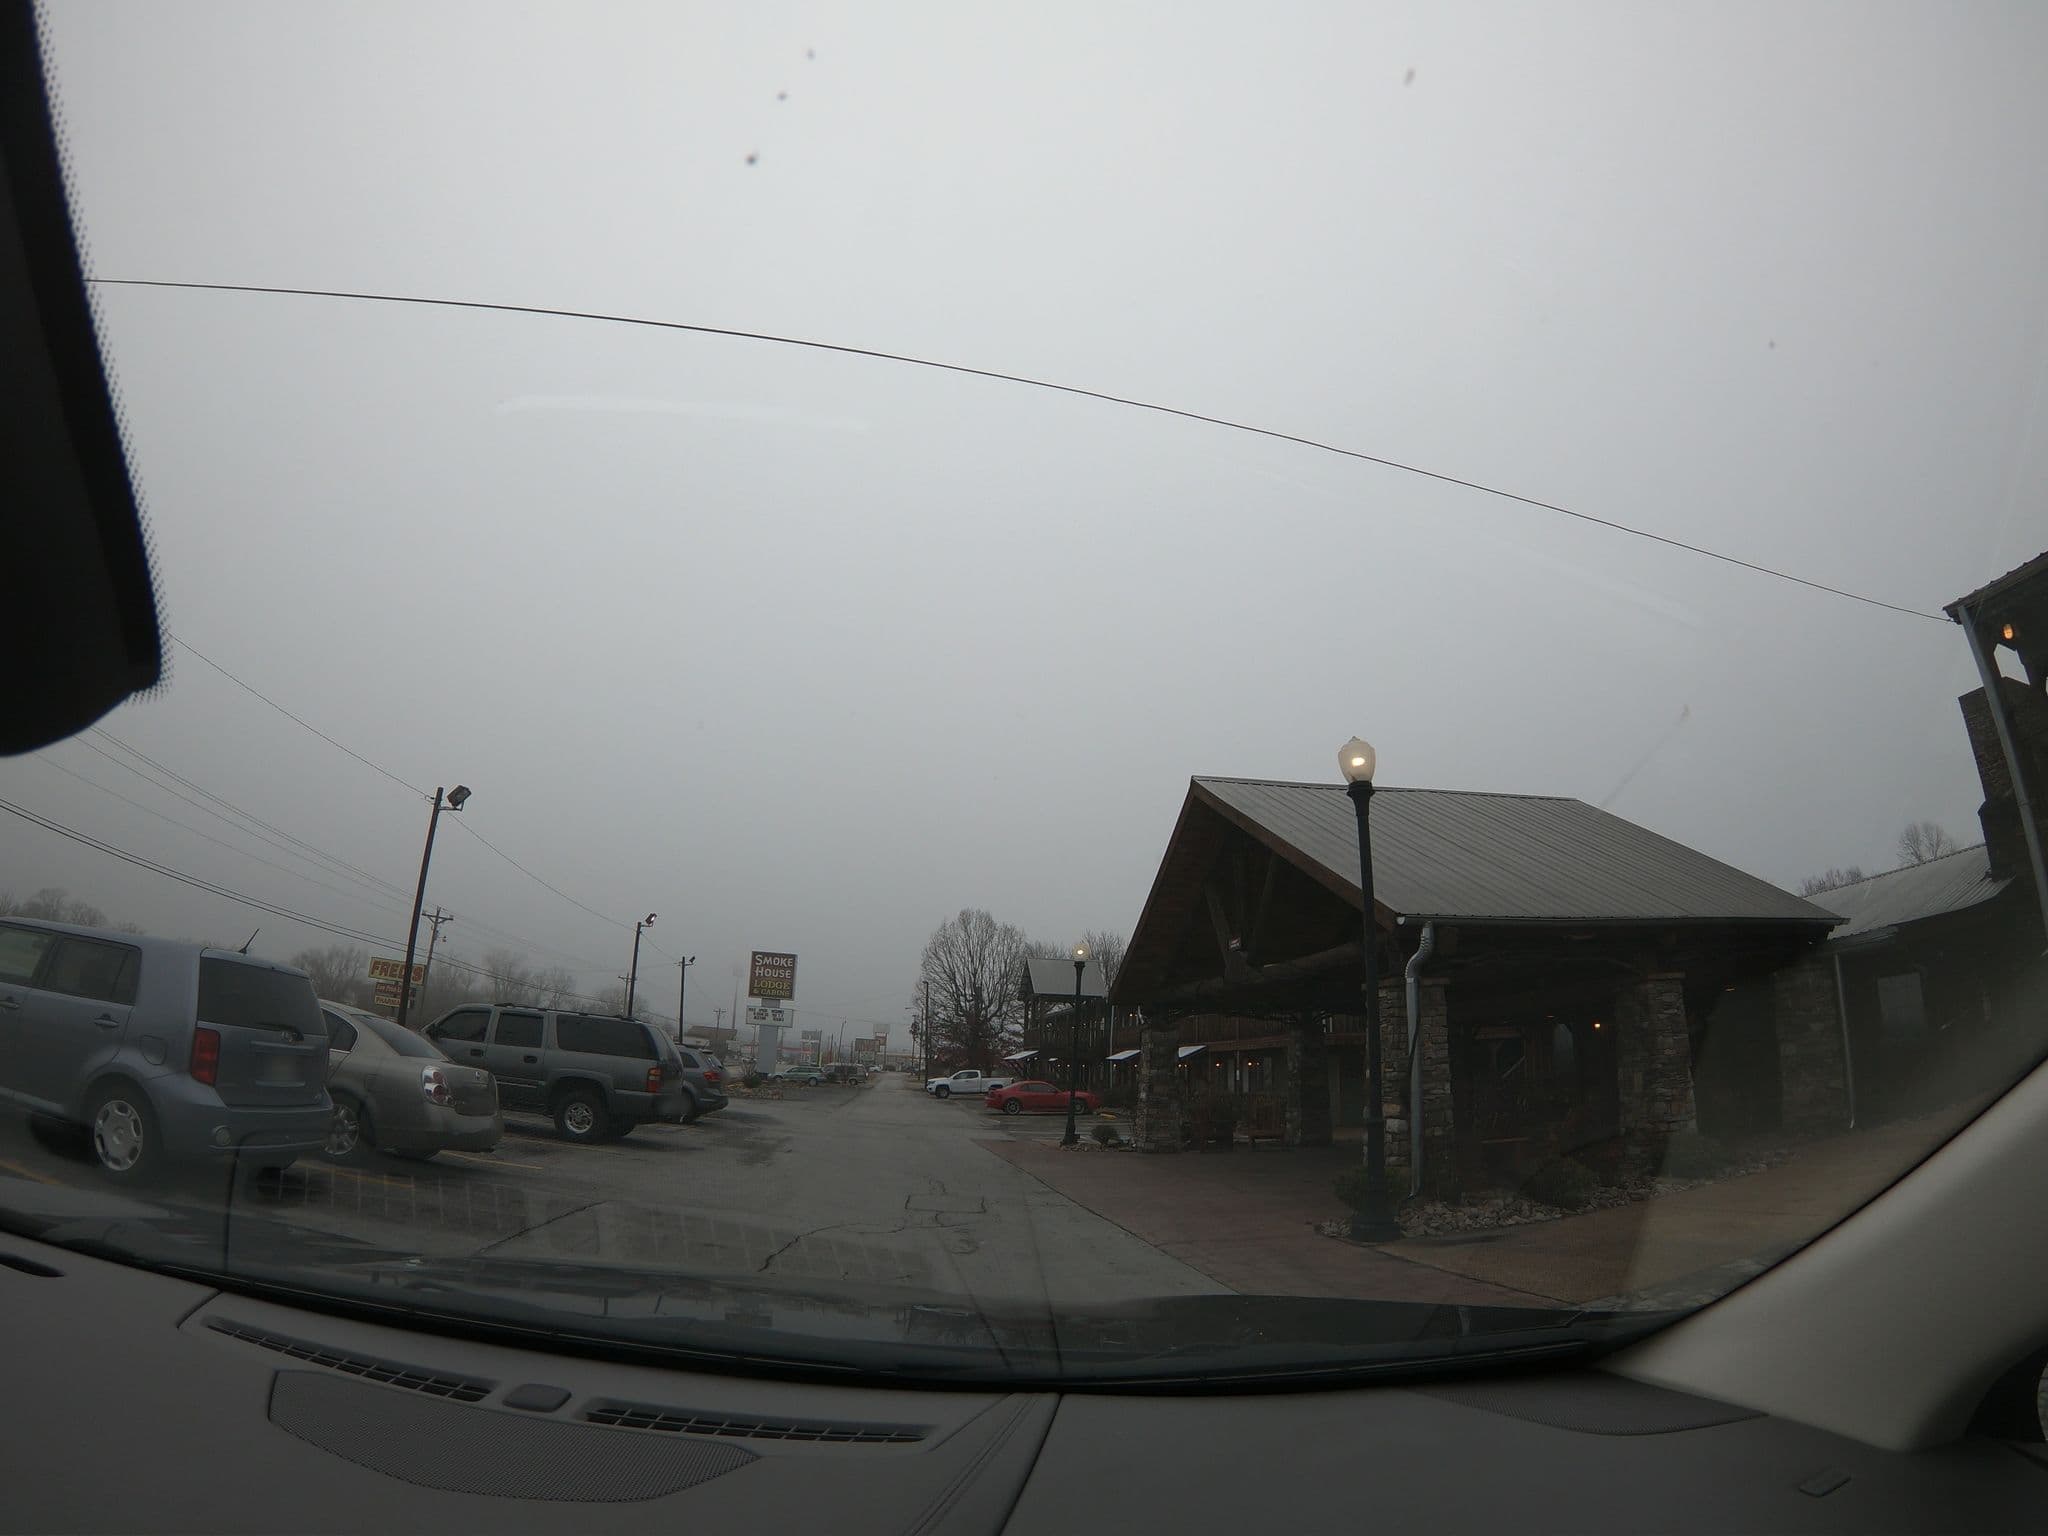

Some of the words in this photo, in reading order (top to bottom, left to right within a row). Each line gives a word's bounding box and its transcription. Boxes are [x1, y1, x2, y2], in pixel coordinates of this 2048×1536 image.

[755, 954, 794, 967] SMOKE
[371, 959, 423, 982] FREDS
[755, 966, 792, 979] HOUSE
[754, 979, 791, 990] LODGE
